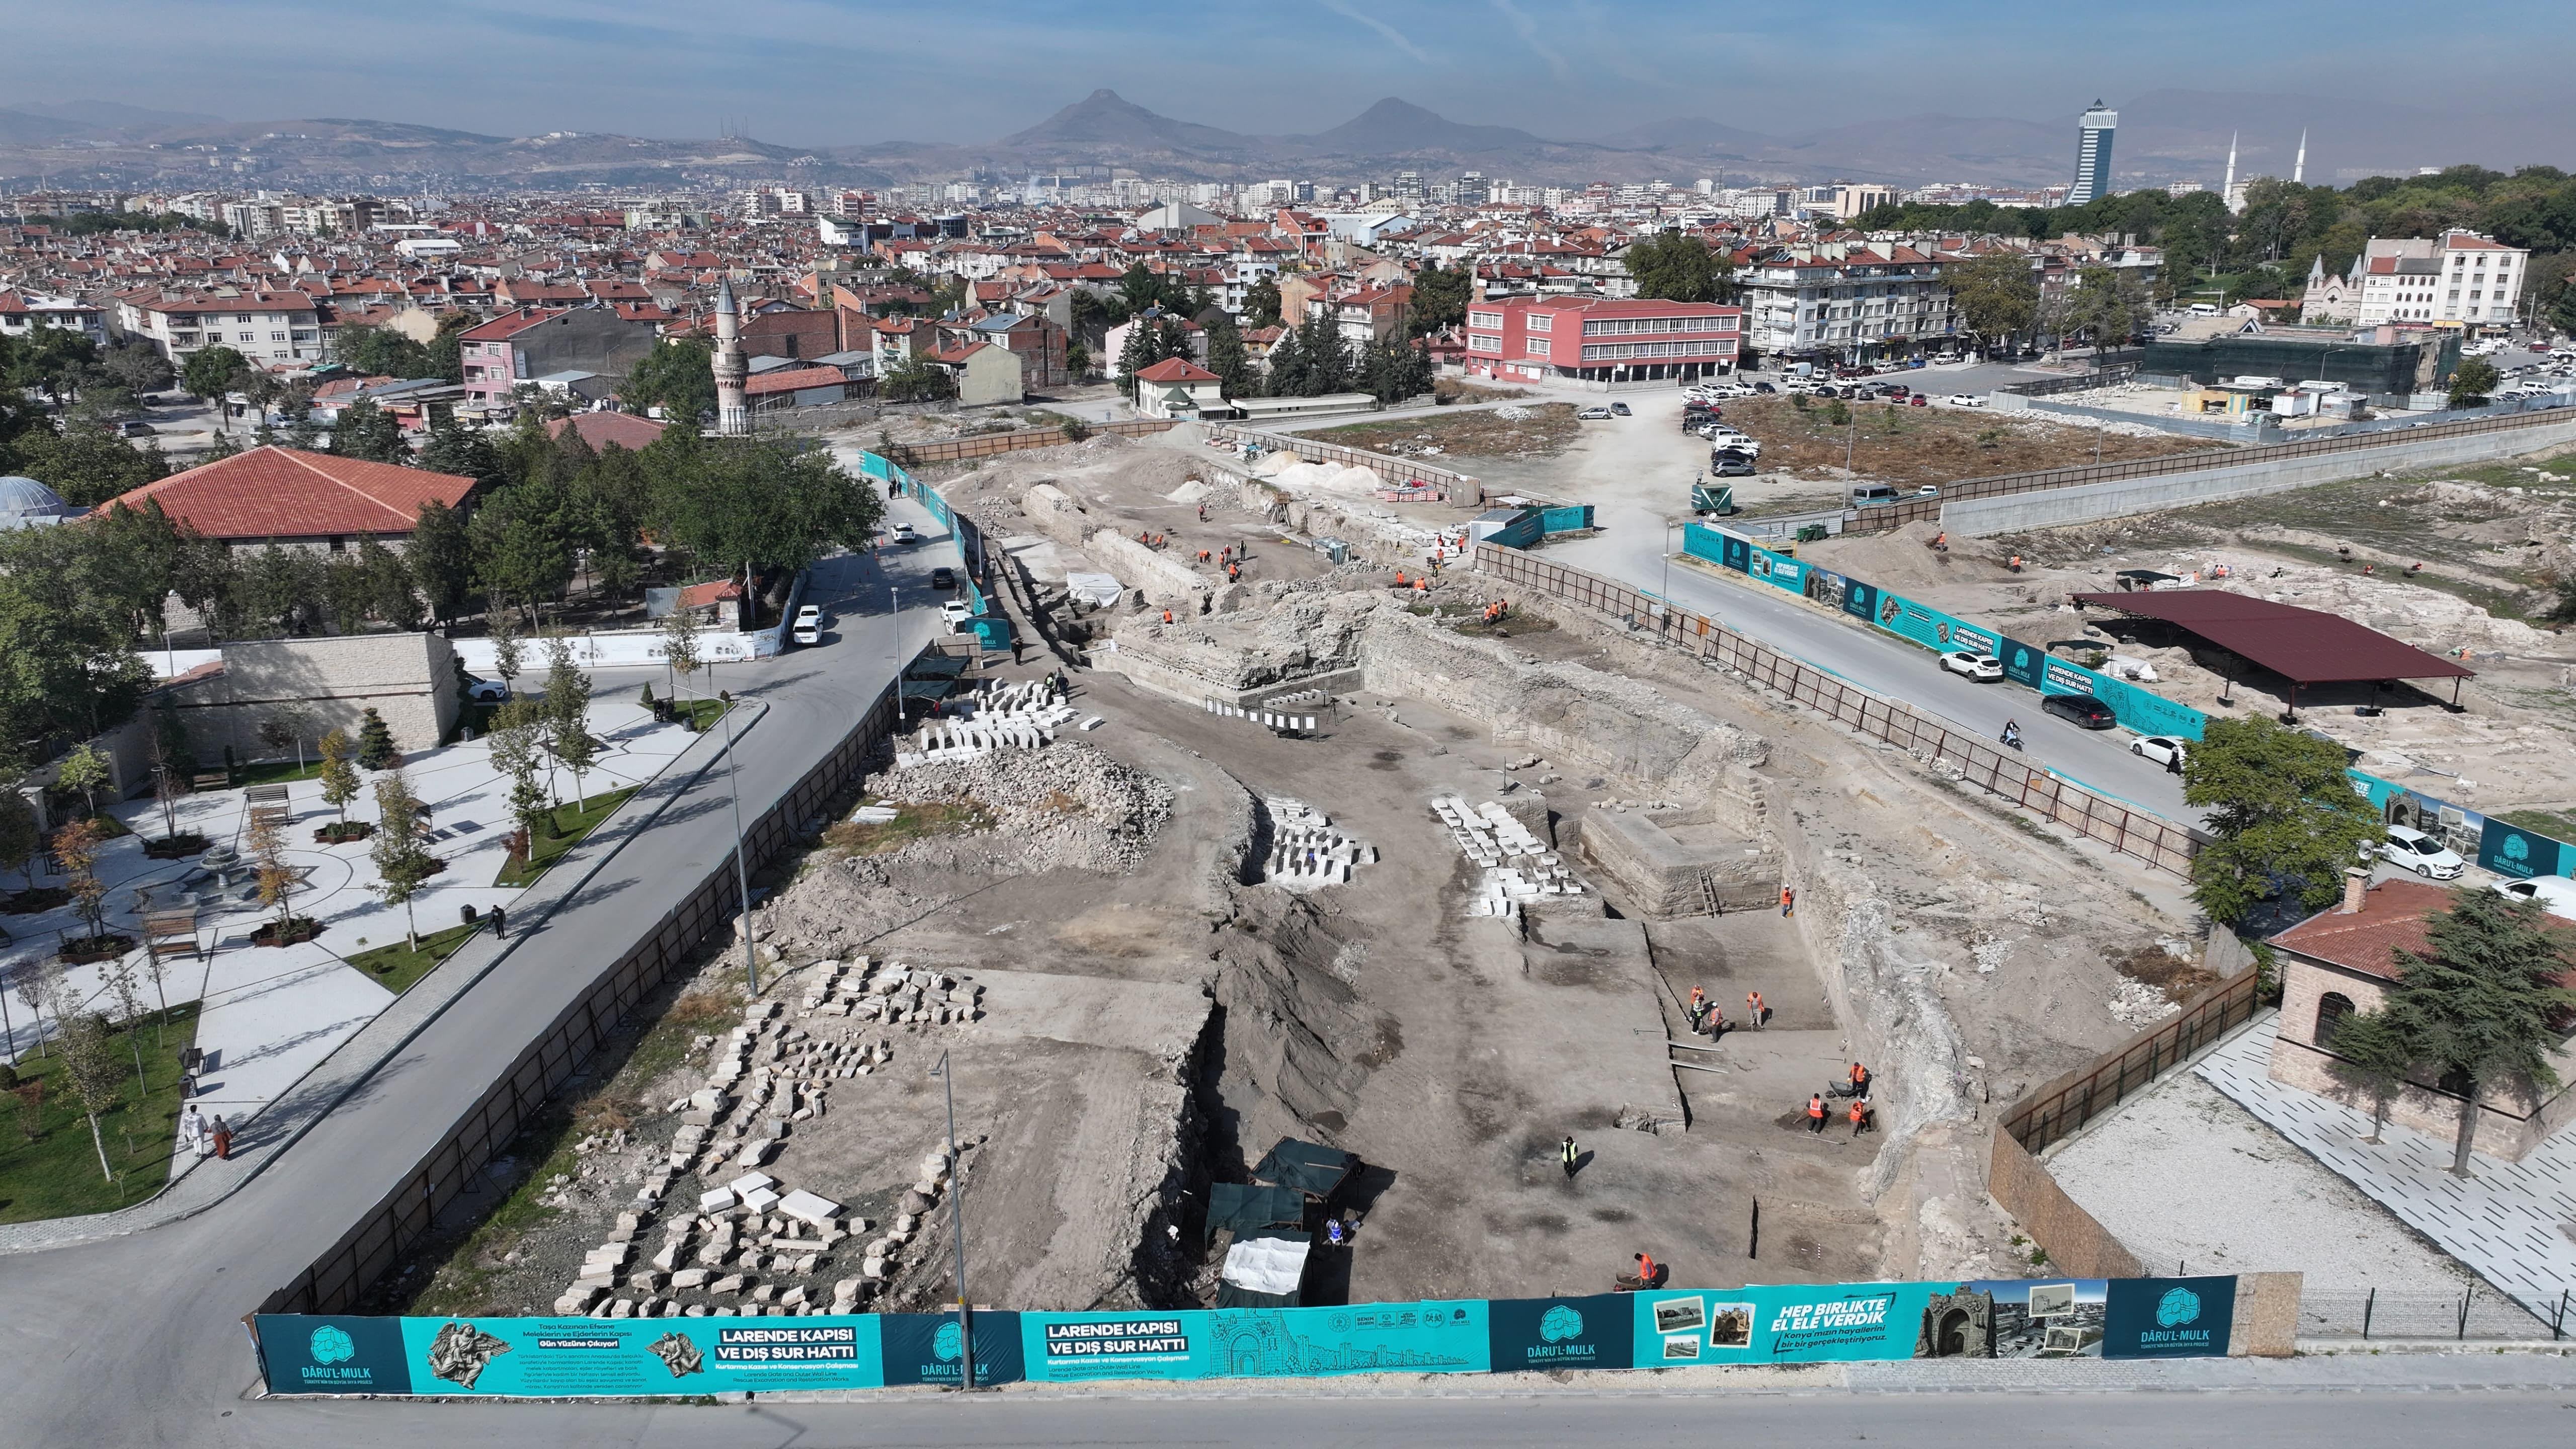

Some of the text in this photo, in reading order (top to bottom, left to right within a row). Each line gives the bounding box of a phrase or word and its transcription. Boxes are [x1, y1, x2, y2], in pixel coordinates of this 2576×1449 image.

[1957, 626, 1993, 646] LARENDE KAPISI
[1968, 639, 1978, 648] SUR
[1978, 643, 1992, 654] HATTI
[2049, 664, 2092, 685] LARENDE KAPISI
[2056, 676, 2065, 685] DIŞ
[2065, 679, 2076, 688] SUR
[2076, 683, 2093, 694] HATTI
[1779, 1299, 1887, 1318] HEP BİRLİKTE
[1770, 1311, 1887, 1332] EL ELE VERDİK
[722, 1329, 853, 1342] LARENDE KAPISI
[1049, 1322, 1178, 1337] LARENDE KAPISI
[1838, 1325, 1886, 1337] hayallerini
[2141, 1330, 2210, 1342] DÂRU'L-MULK
[587, 1340, 618, 1348] Çıkıyor!
[1050, 1338, 1185, 1355] VE DIŞ SUR HATTI
[1527, 1344, 1595, 1357] DÂRU'L-MULK
[717, 1346, 854, 1361] VE DIŞ SUR HATTI
[301, 1365, 371, 1378] DÂRU'L-MULK
[921, 1362, 988, 1375] DÂRU'L-LK
